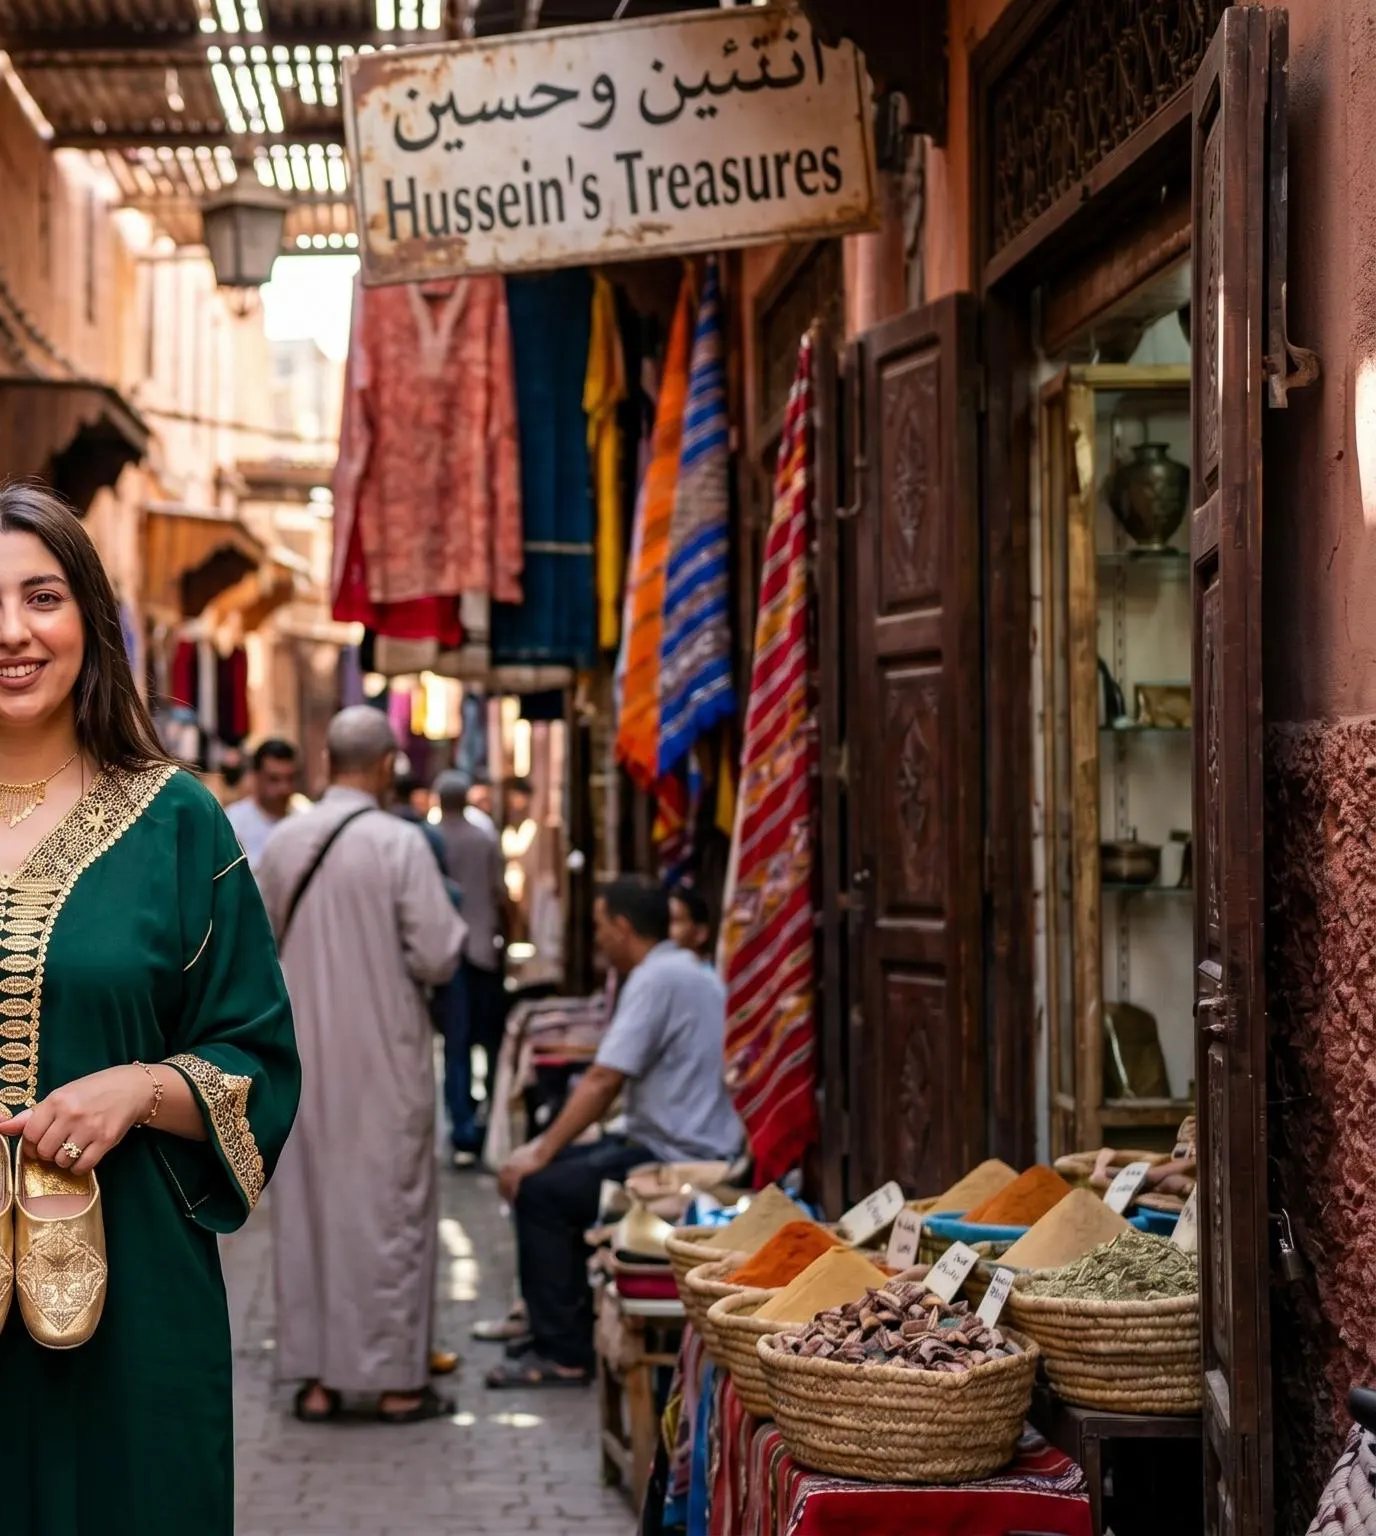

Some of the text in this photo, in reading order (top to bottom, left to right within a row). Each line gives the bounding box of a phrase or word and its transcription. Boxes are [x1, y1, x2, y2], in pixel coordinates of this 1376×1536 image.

[393, 71, 617, 153] وحسين
[383, 145, 843, 241] Hussein's Treasures
